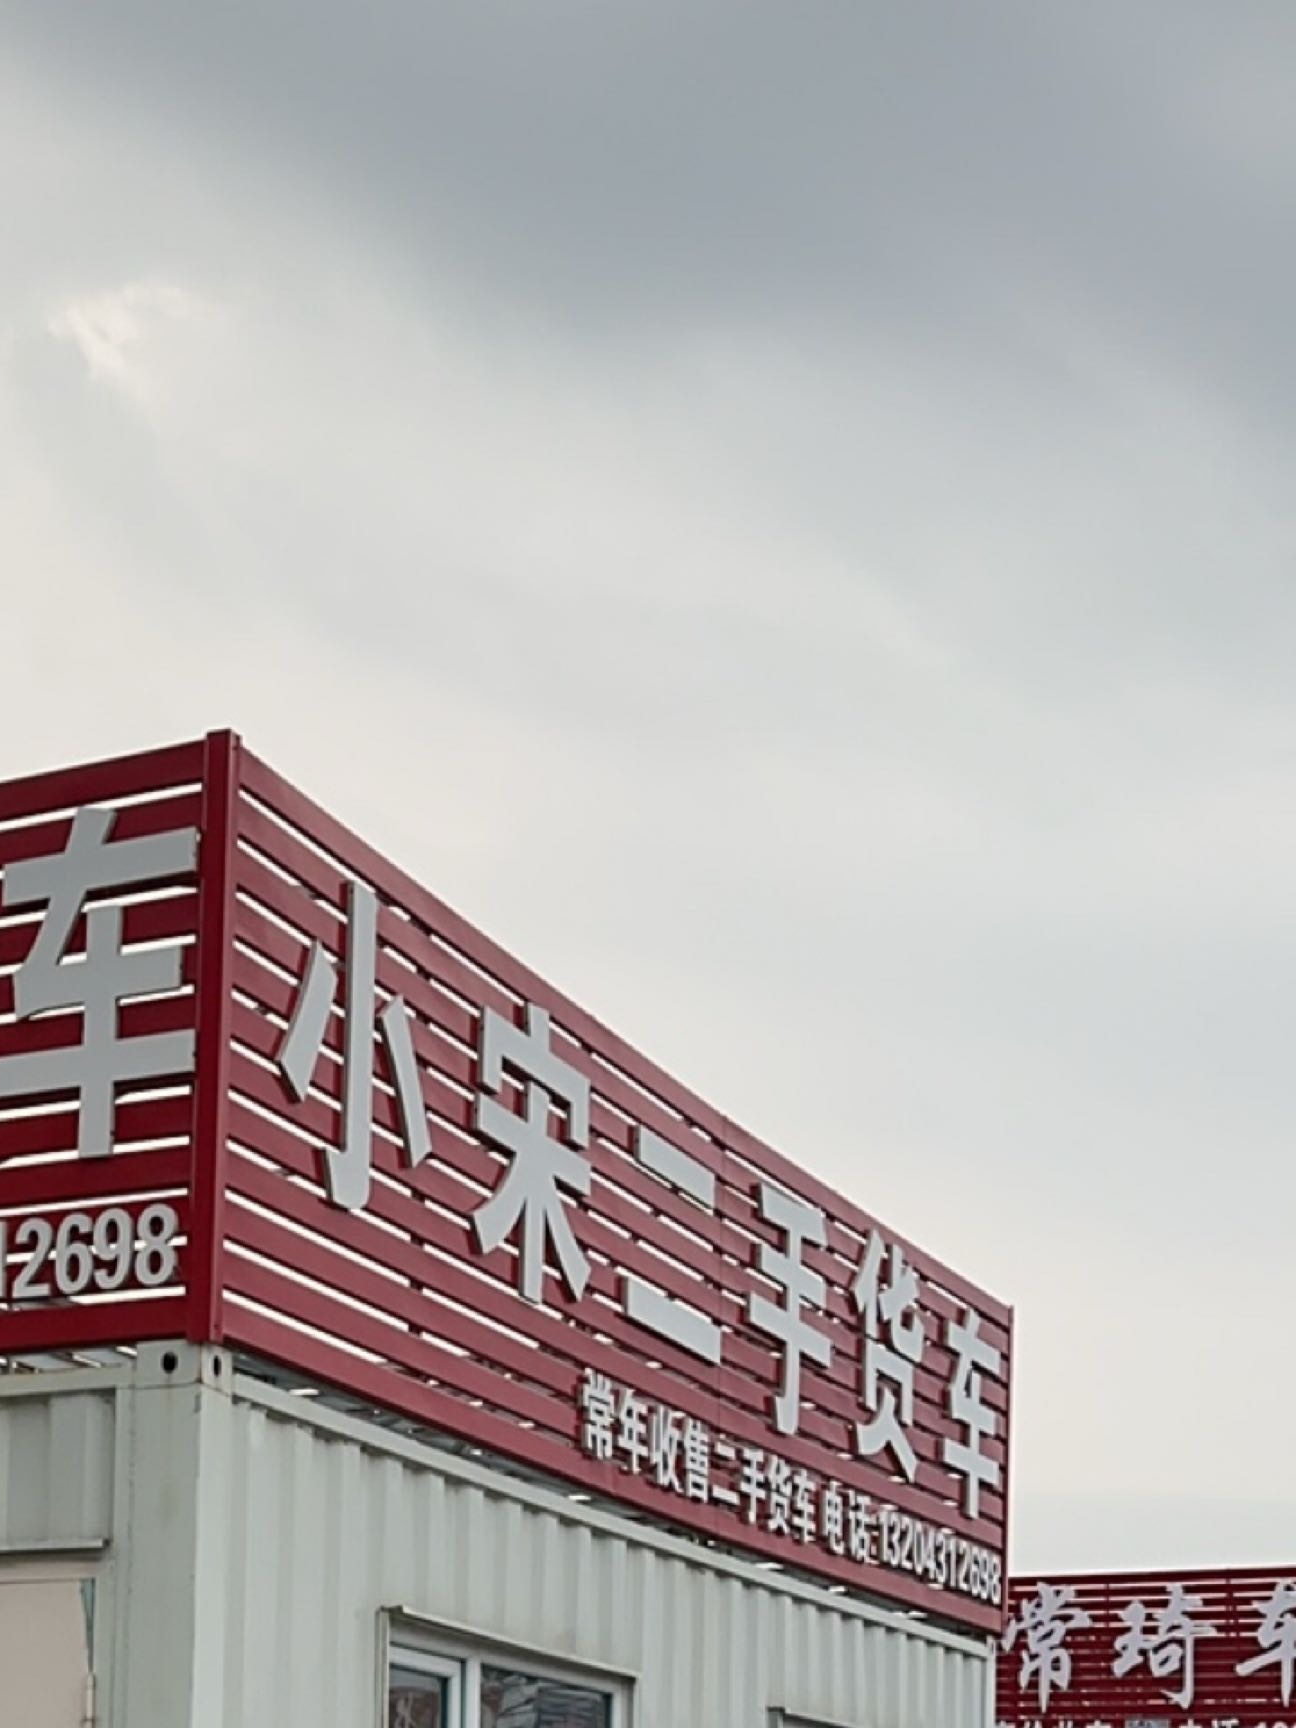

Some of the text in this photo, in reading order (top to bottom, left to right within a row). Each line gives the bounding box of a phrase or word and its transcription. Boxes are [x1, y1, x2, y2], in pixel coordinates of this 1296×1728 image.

[279, 880, 1002, 1519] 小宋二手货车
[583, 1367, 817, 1544] 常年收售二手货车
